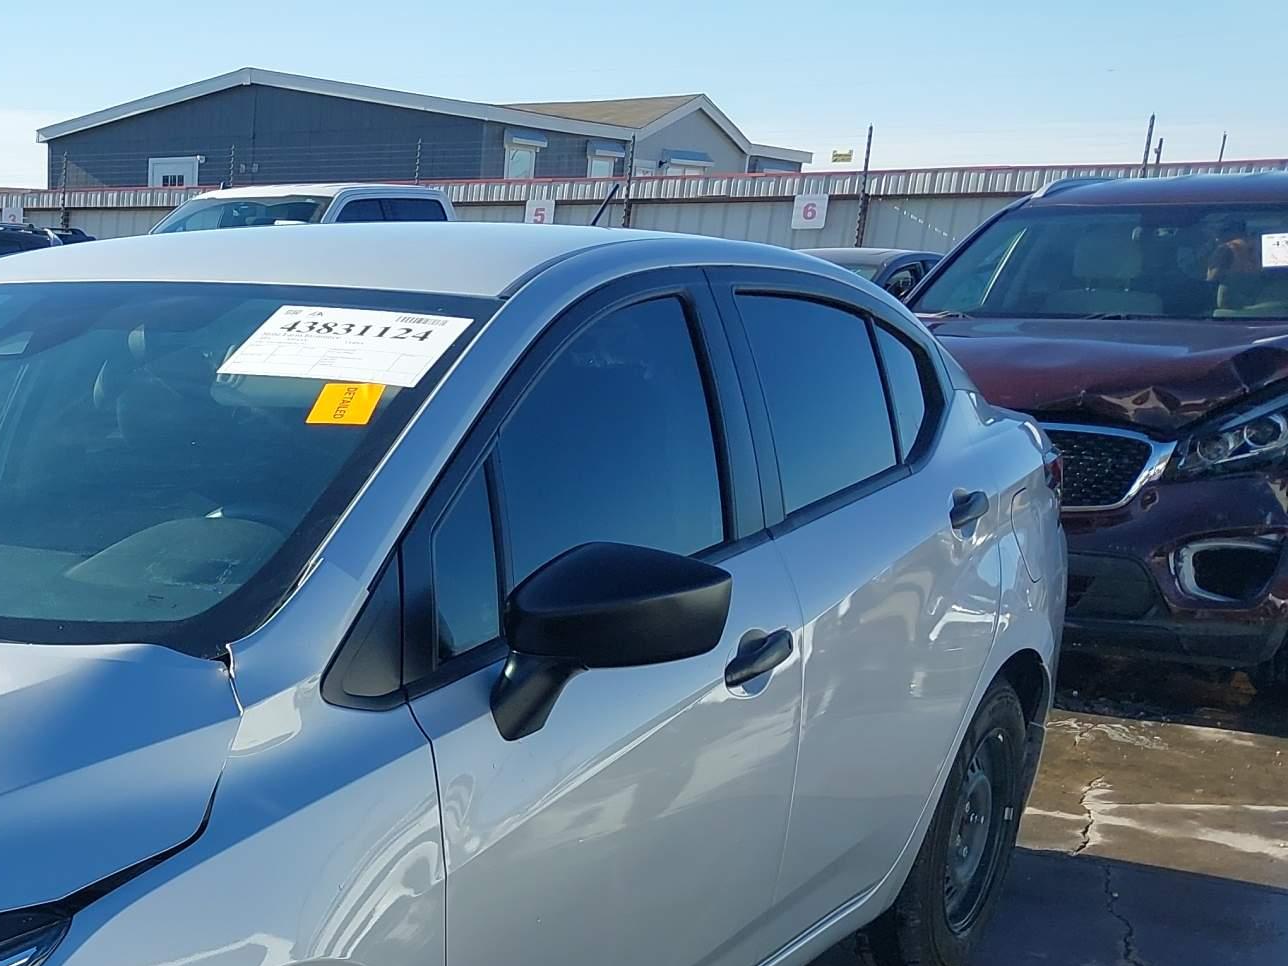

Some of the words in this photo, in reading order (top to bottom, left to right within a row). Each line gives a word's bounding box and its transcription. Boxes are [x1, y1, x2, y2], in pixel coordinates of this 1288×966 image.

[533, 207, 545, 224] 5
[803, 203, 817, 220] 6
[280, 320, 433, 342] 43831124
[333, 387, 358, 419] DETAILED
